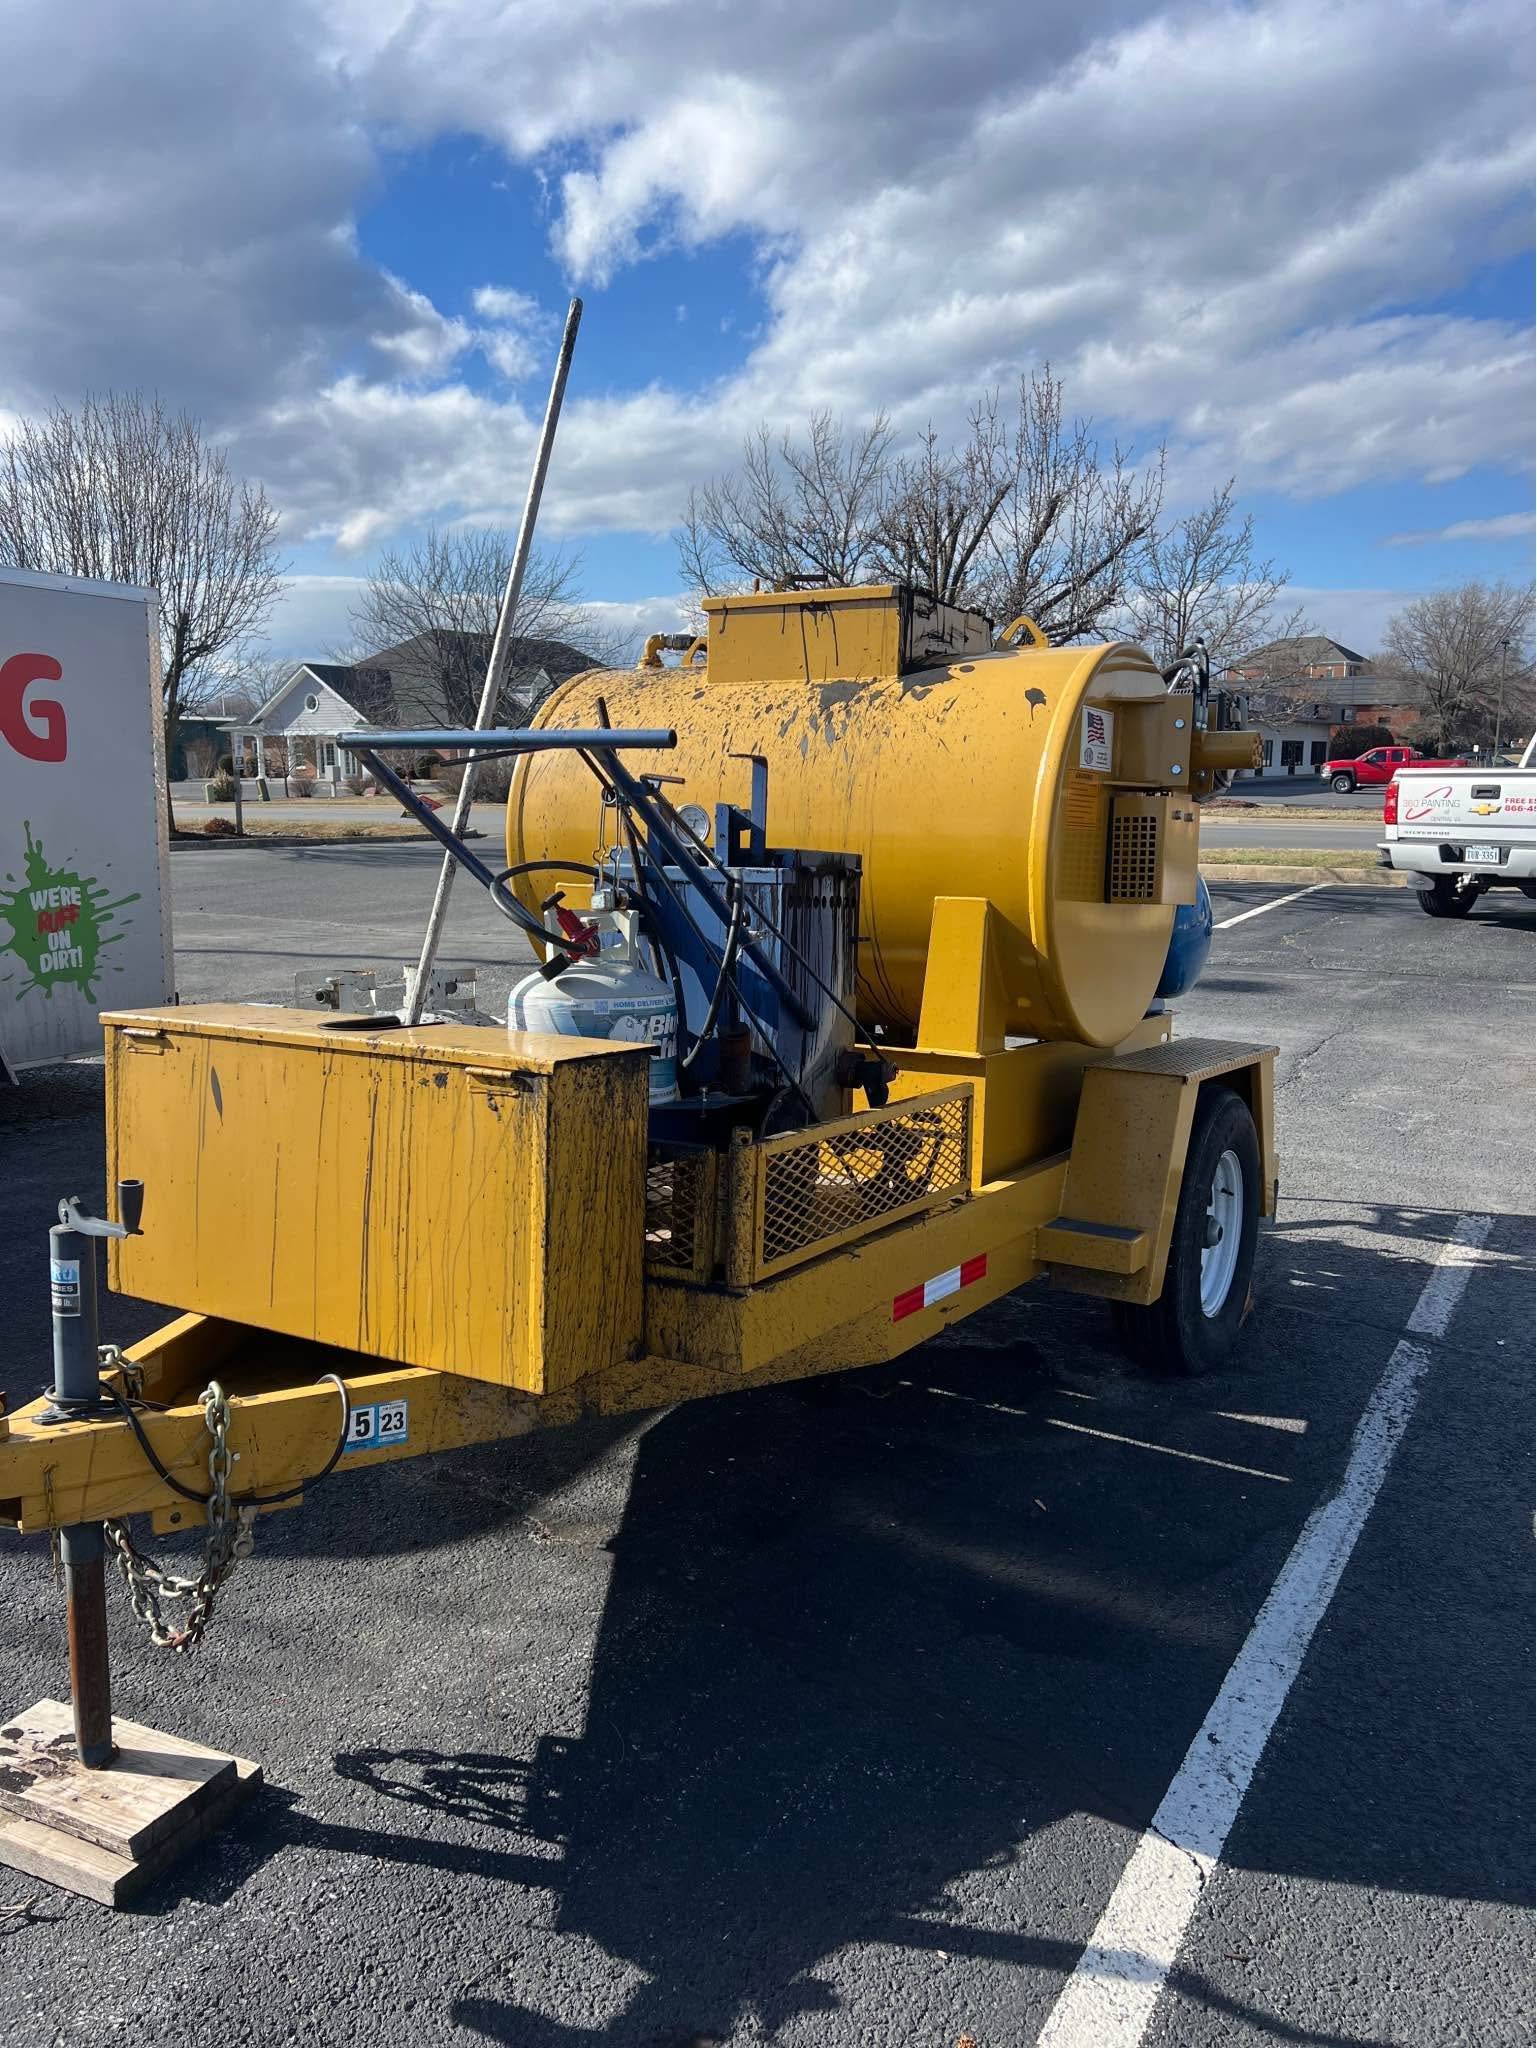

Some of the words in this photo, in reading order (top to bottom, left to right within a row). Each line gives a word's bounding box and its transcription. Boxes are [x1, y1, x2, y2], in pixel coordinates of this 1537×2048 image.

[0, 653, 67, 763] G
[1421, 799, 1461, 808] PAINTING
[48, 930, 71, 951] ON
[40, 946, 83, 974] DIRT!
[614, 1000, 636, 1008] HOME
[356, 1411, 370, 1437] 5
[381, 1411, 404, 1432] 23
